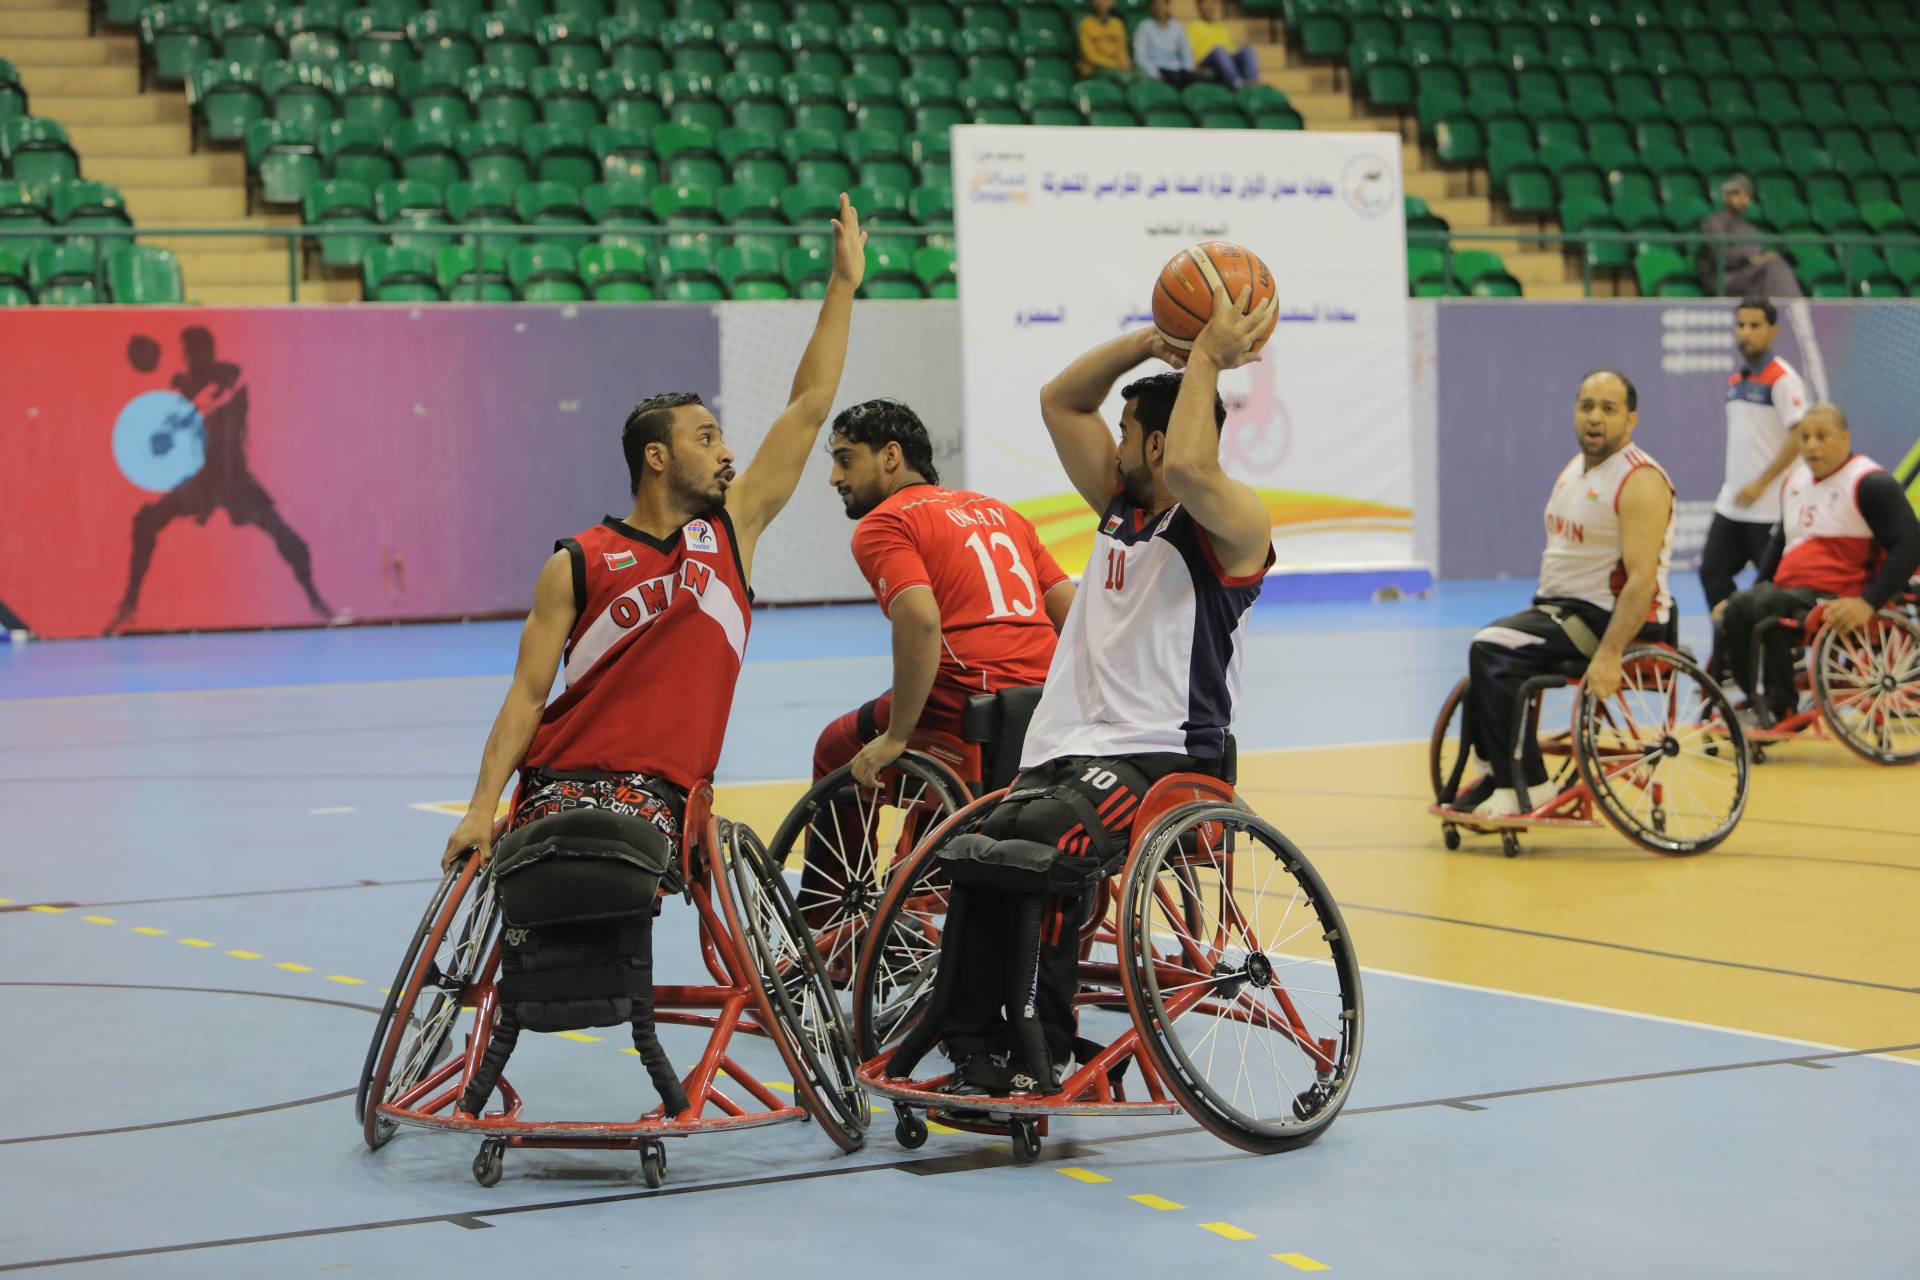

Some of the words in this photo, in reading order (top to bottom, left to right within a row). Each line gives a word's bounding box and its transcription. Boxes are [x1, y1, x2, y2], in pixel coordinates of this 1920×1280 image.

[964, 531, 1037, 619] 13
[1105, 548, 1126, 591] 10
[1079, 766, 1118, 790] 10
